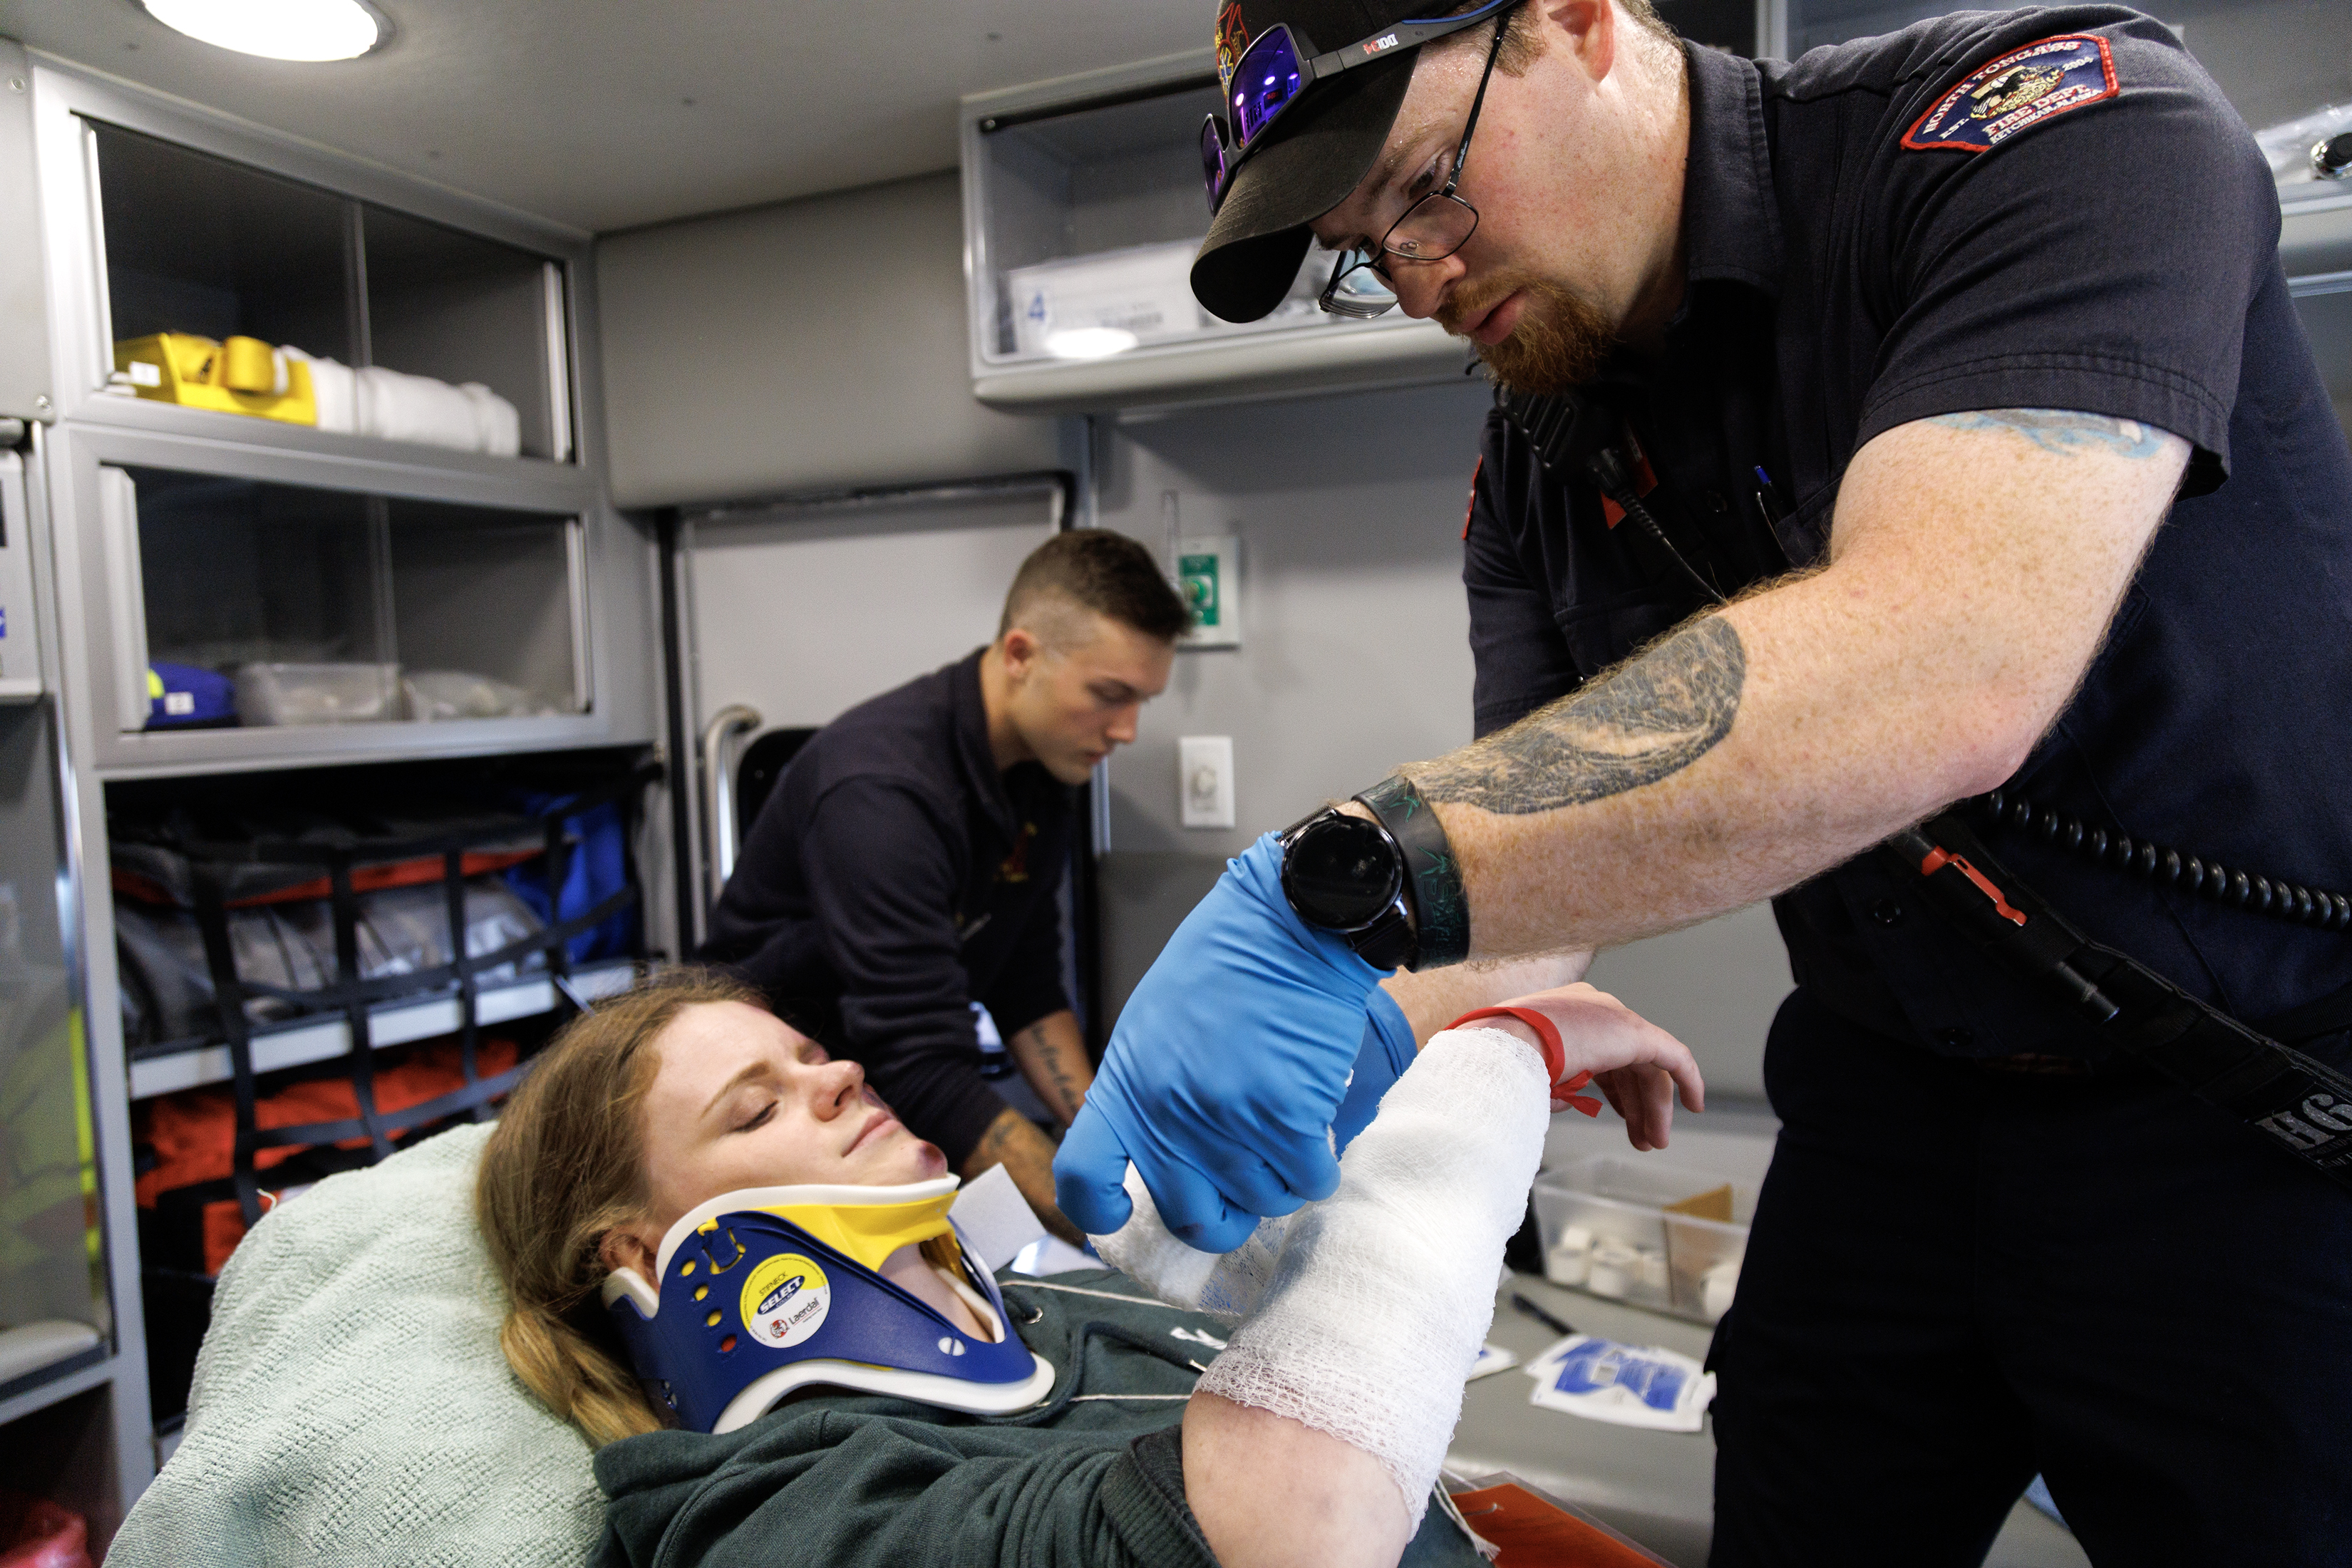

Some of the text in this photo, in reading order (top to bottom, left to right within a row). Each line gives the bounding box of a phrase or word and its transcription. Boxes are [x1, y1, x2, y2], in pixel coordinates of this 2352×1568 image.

[1922, 41, 2082, 135] NORTH TONGASS
[1939, 56, 2094, 140] EST. 2004
[1982, 107, 2033, 137] FIRE
[758, 1272, 788, 1296] STIFNECK
[760, 1276, 802, 1314] SELECT
[788, 1297, 820, 1325] Laerdal
